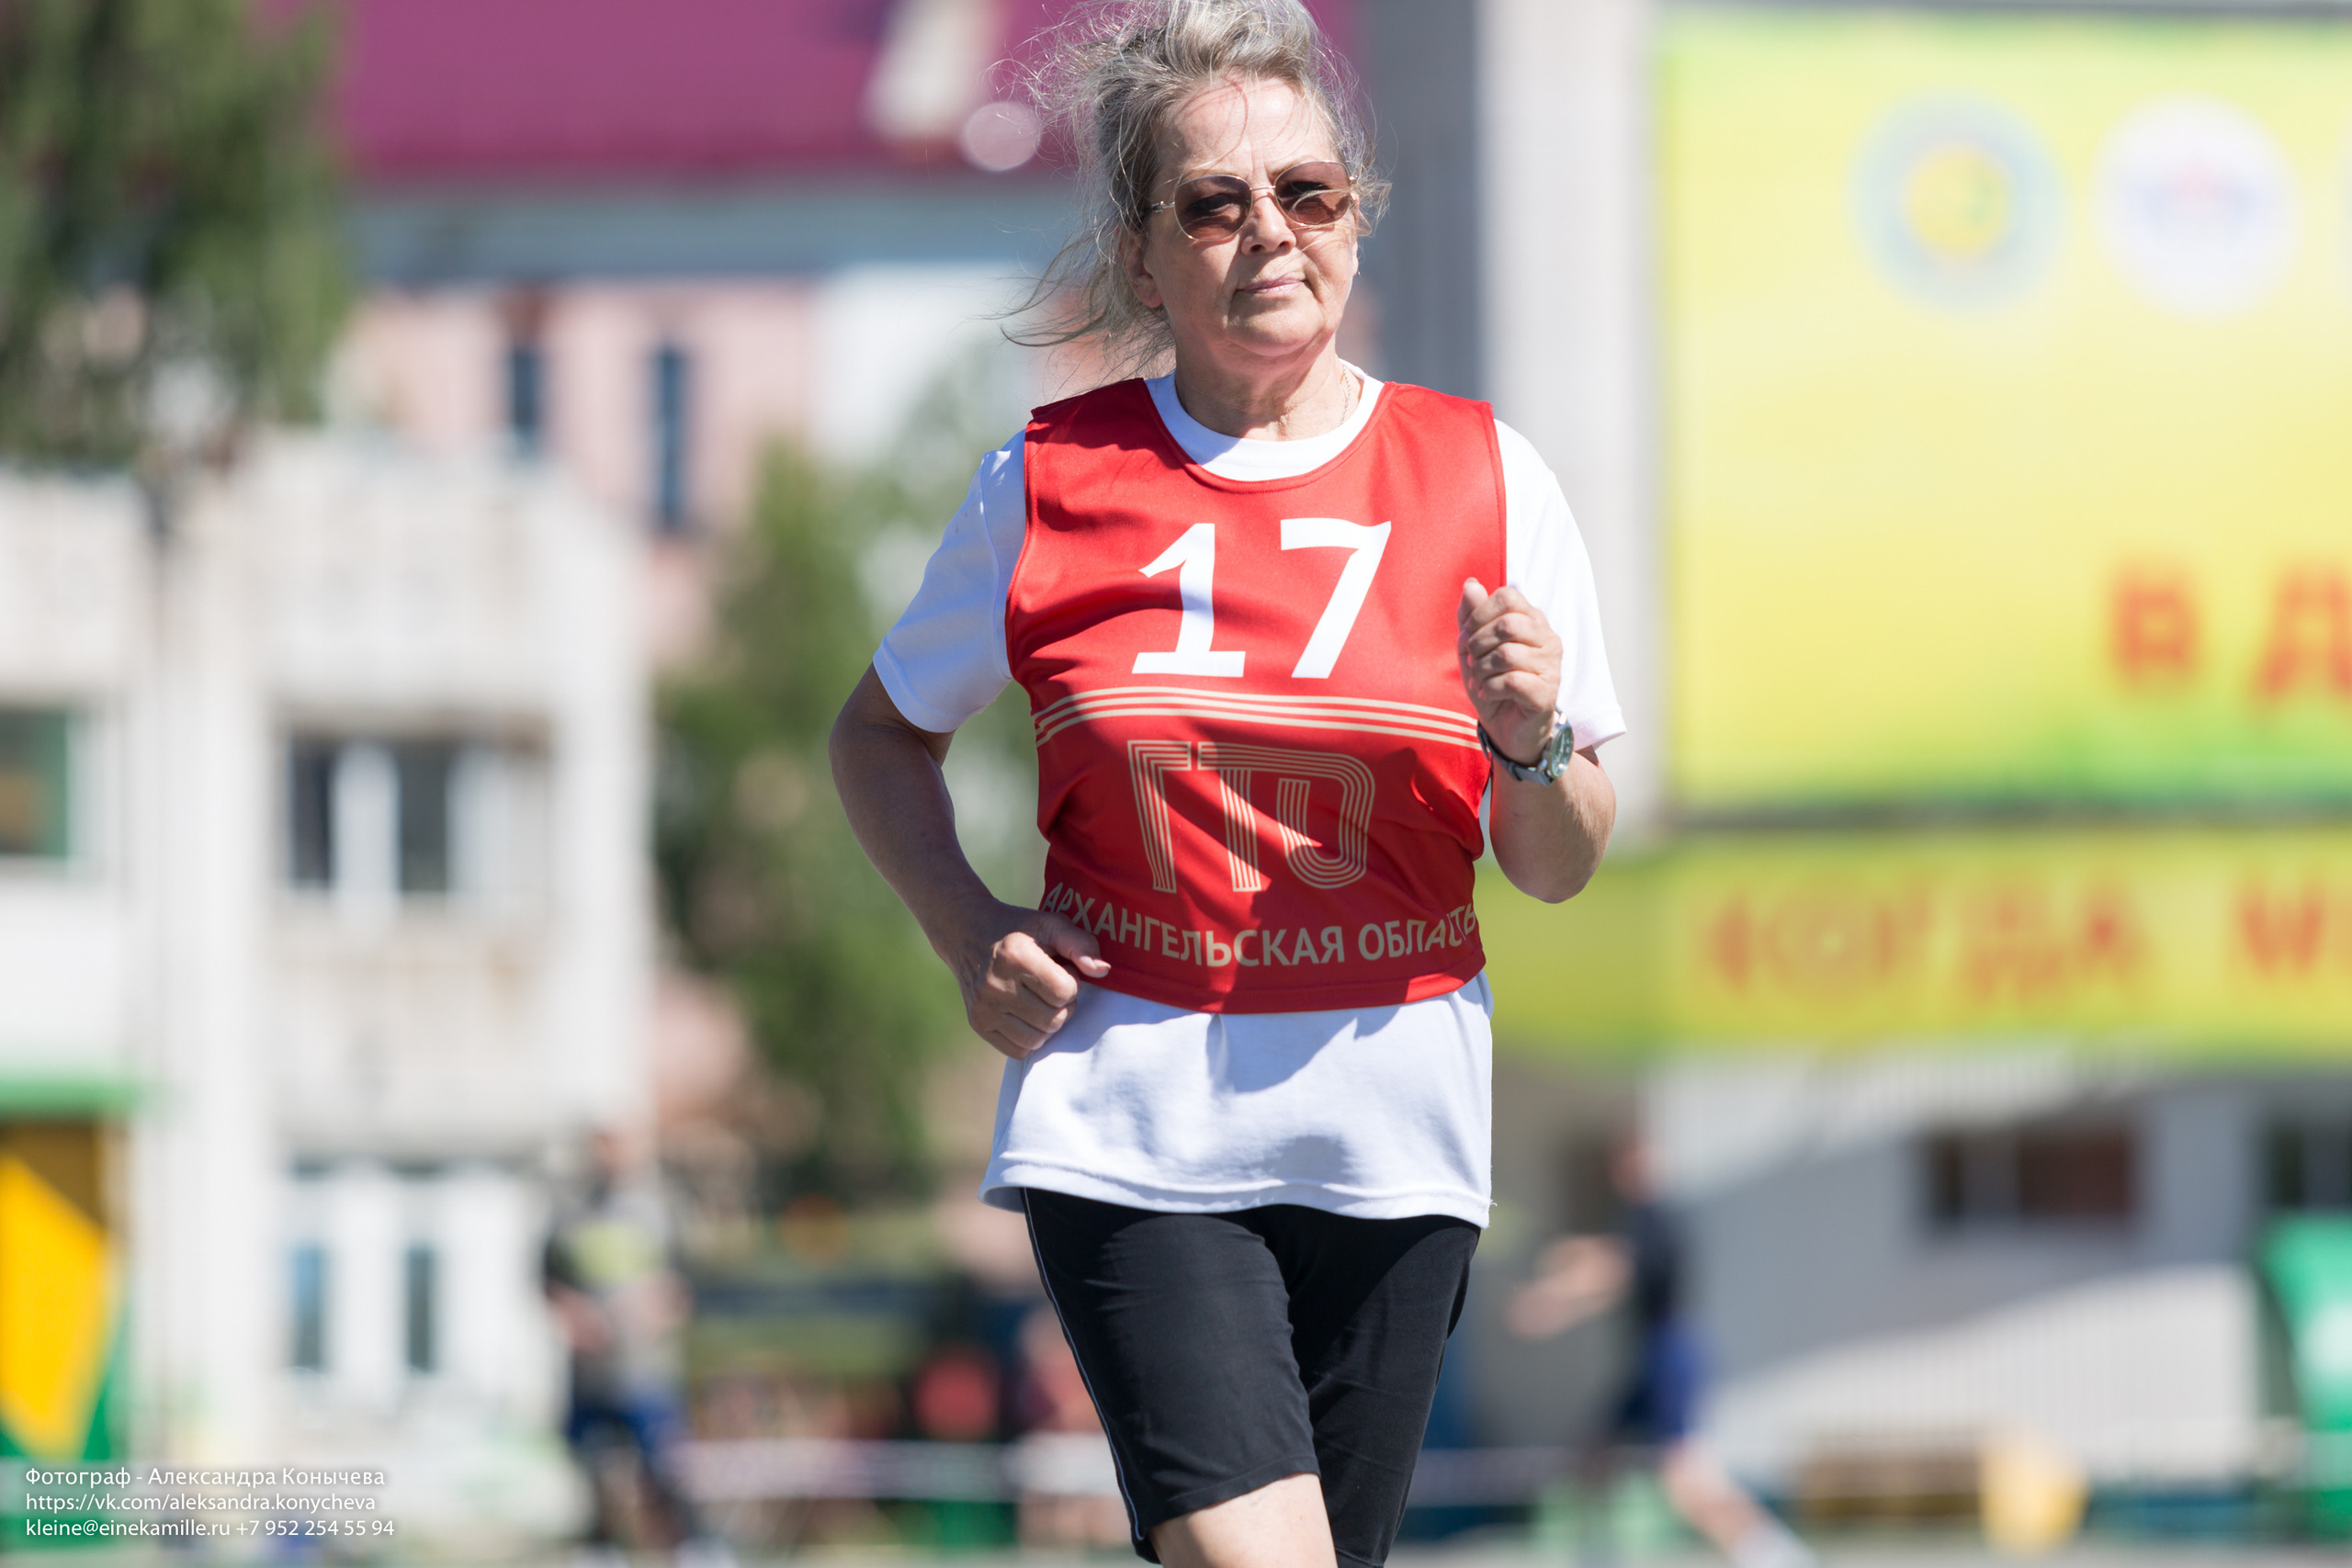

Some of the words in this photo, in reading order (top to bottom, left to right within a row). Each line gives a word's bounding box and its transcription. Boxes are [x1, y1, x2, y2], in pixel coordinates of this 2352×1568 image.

[1131, 517, 1392, 679] 17
[1127, 739, 1376, 893] ГТО
[1041, 881, 1346, 968] АРХАНГЕЛЬСКАЯ
